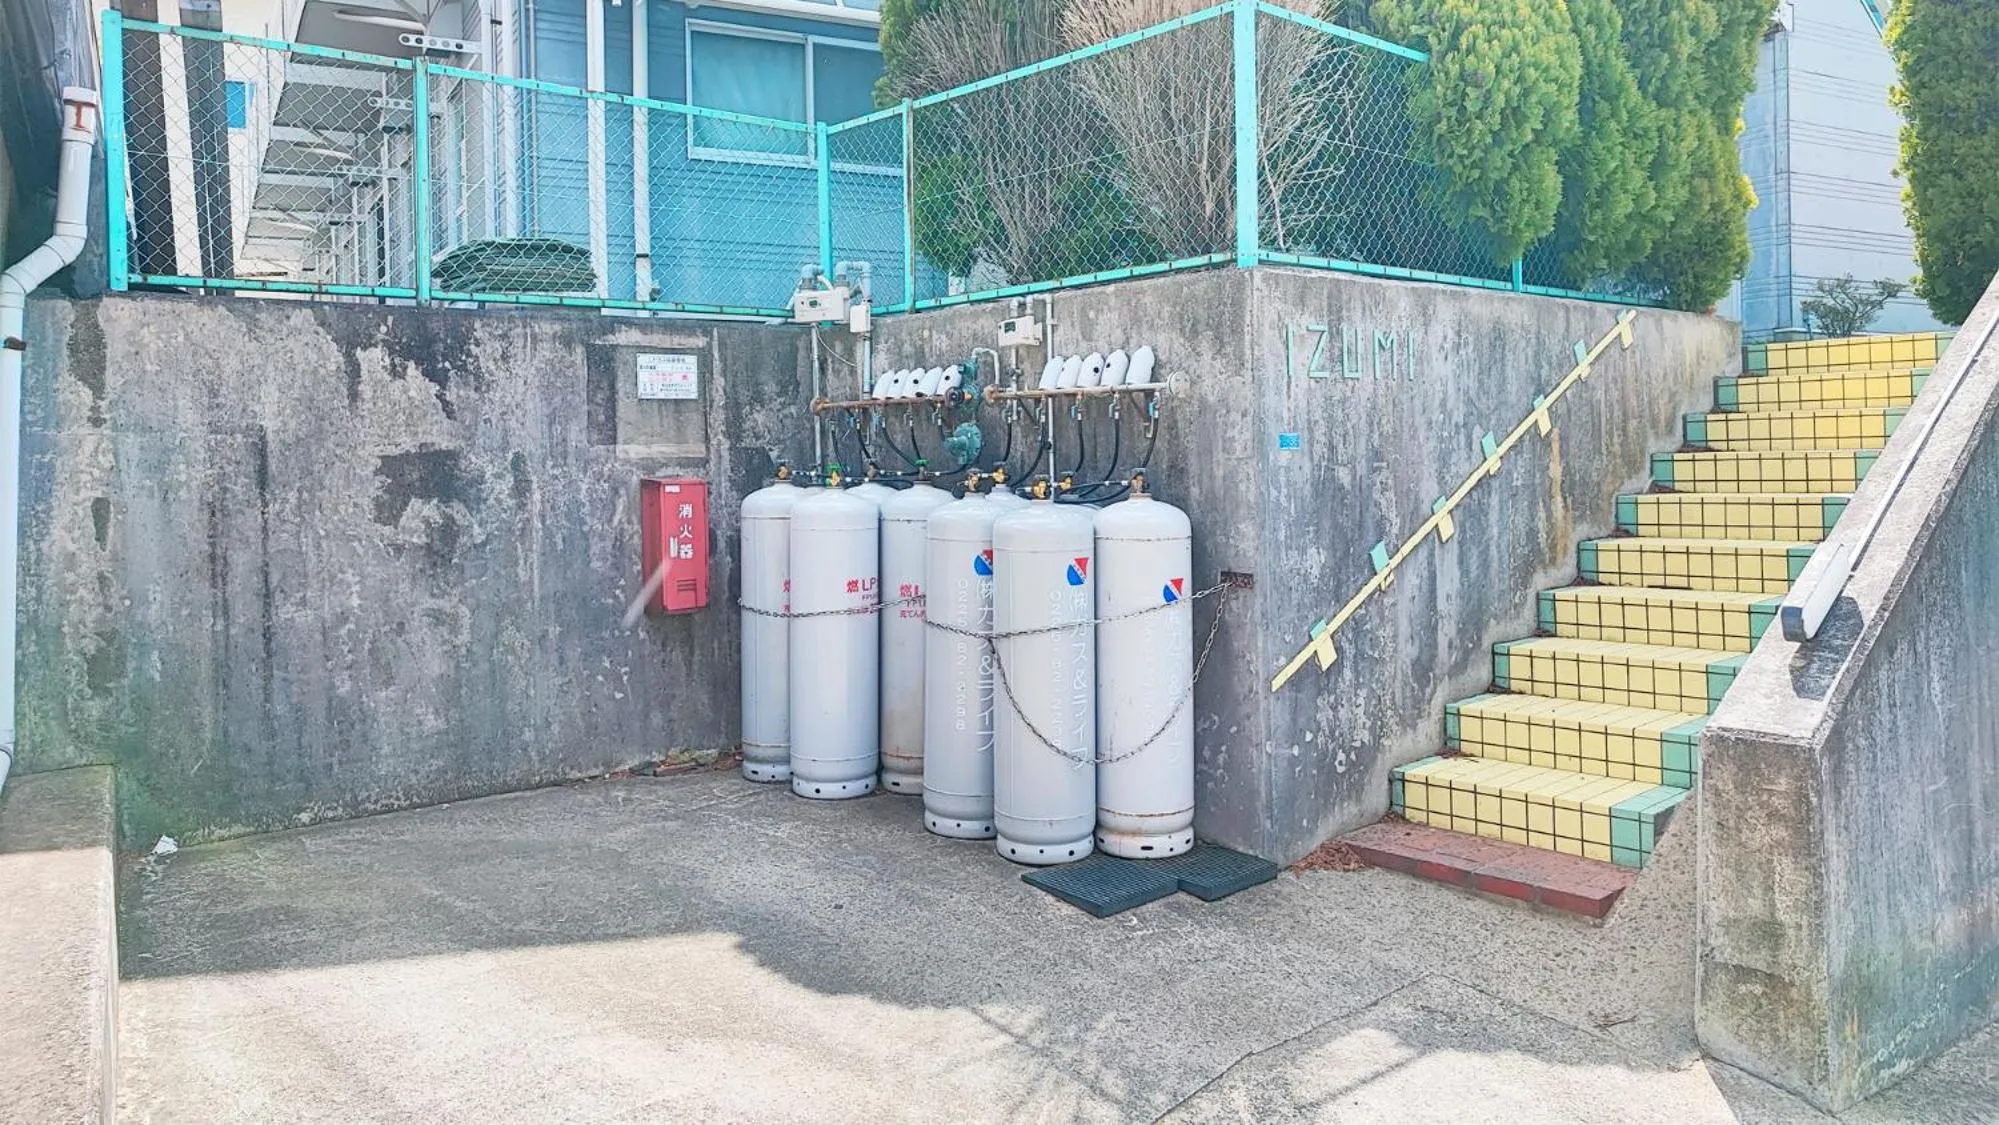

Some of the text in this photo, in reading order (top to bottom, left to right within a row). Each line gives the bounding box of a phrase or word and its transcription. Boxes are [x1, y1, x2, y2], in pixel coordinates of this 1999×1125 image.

[1284, 322, 1415, 382] IZUMI
[678, 503, 694, 559] 消火器
